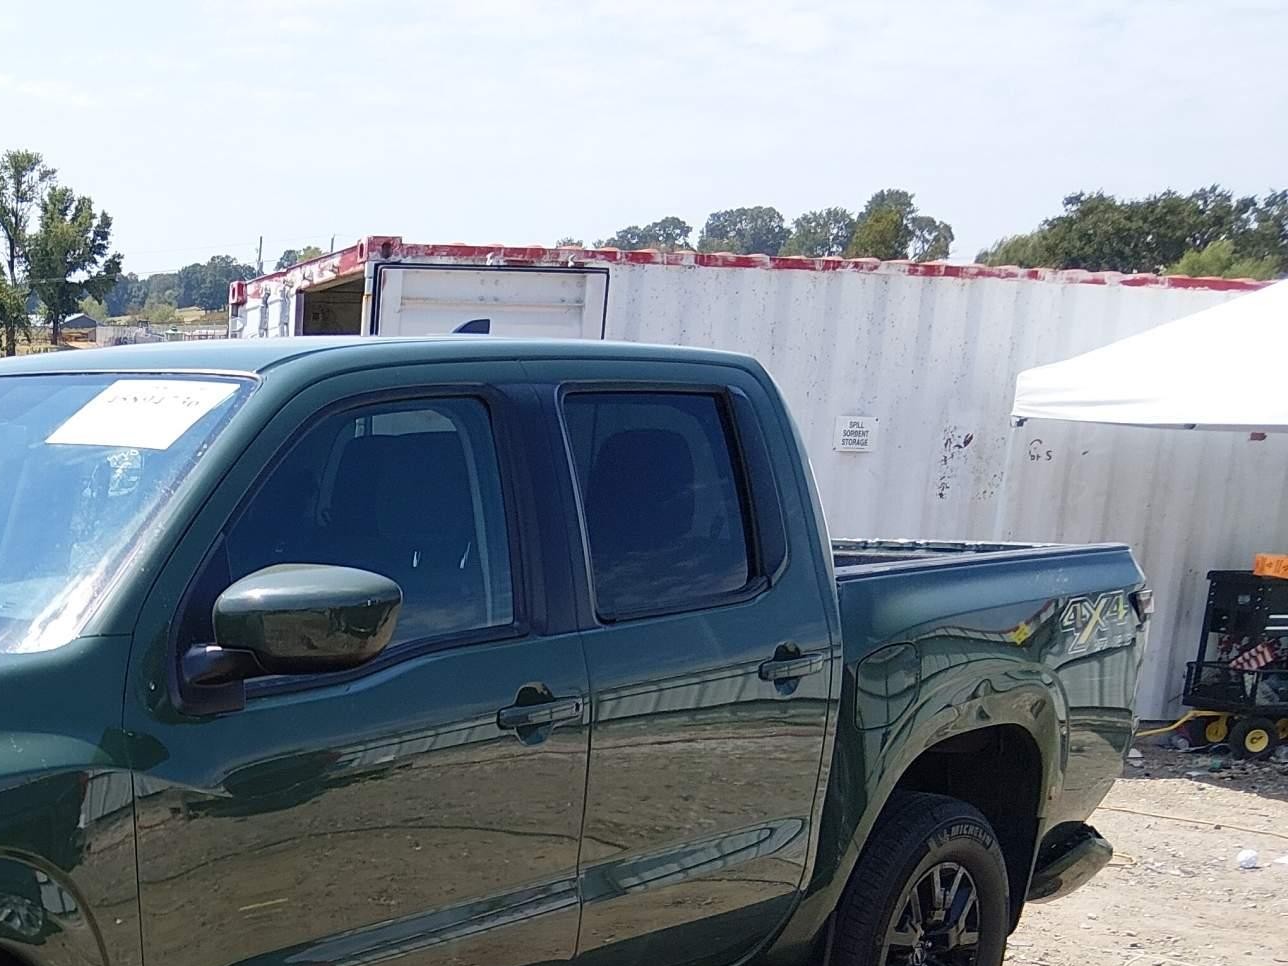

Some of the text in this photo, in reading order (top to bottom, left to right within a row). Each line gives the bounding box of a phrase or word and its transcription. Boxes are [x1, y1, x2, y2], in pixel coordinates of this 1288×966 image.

[849, 420, 864, 428] SPILL
[841, 438, 868, 446] STORAGE
[1059, 590, 1129, 654] 4X4
[951, 824, 993, 846] MICHELIN
